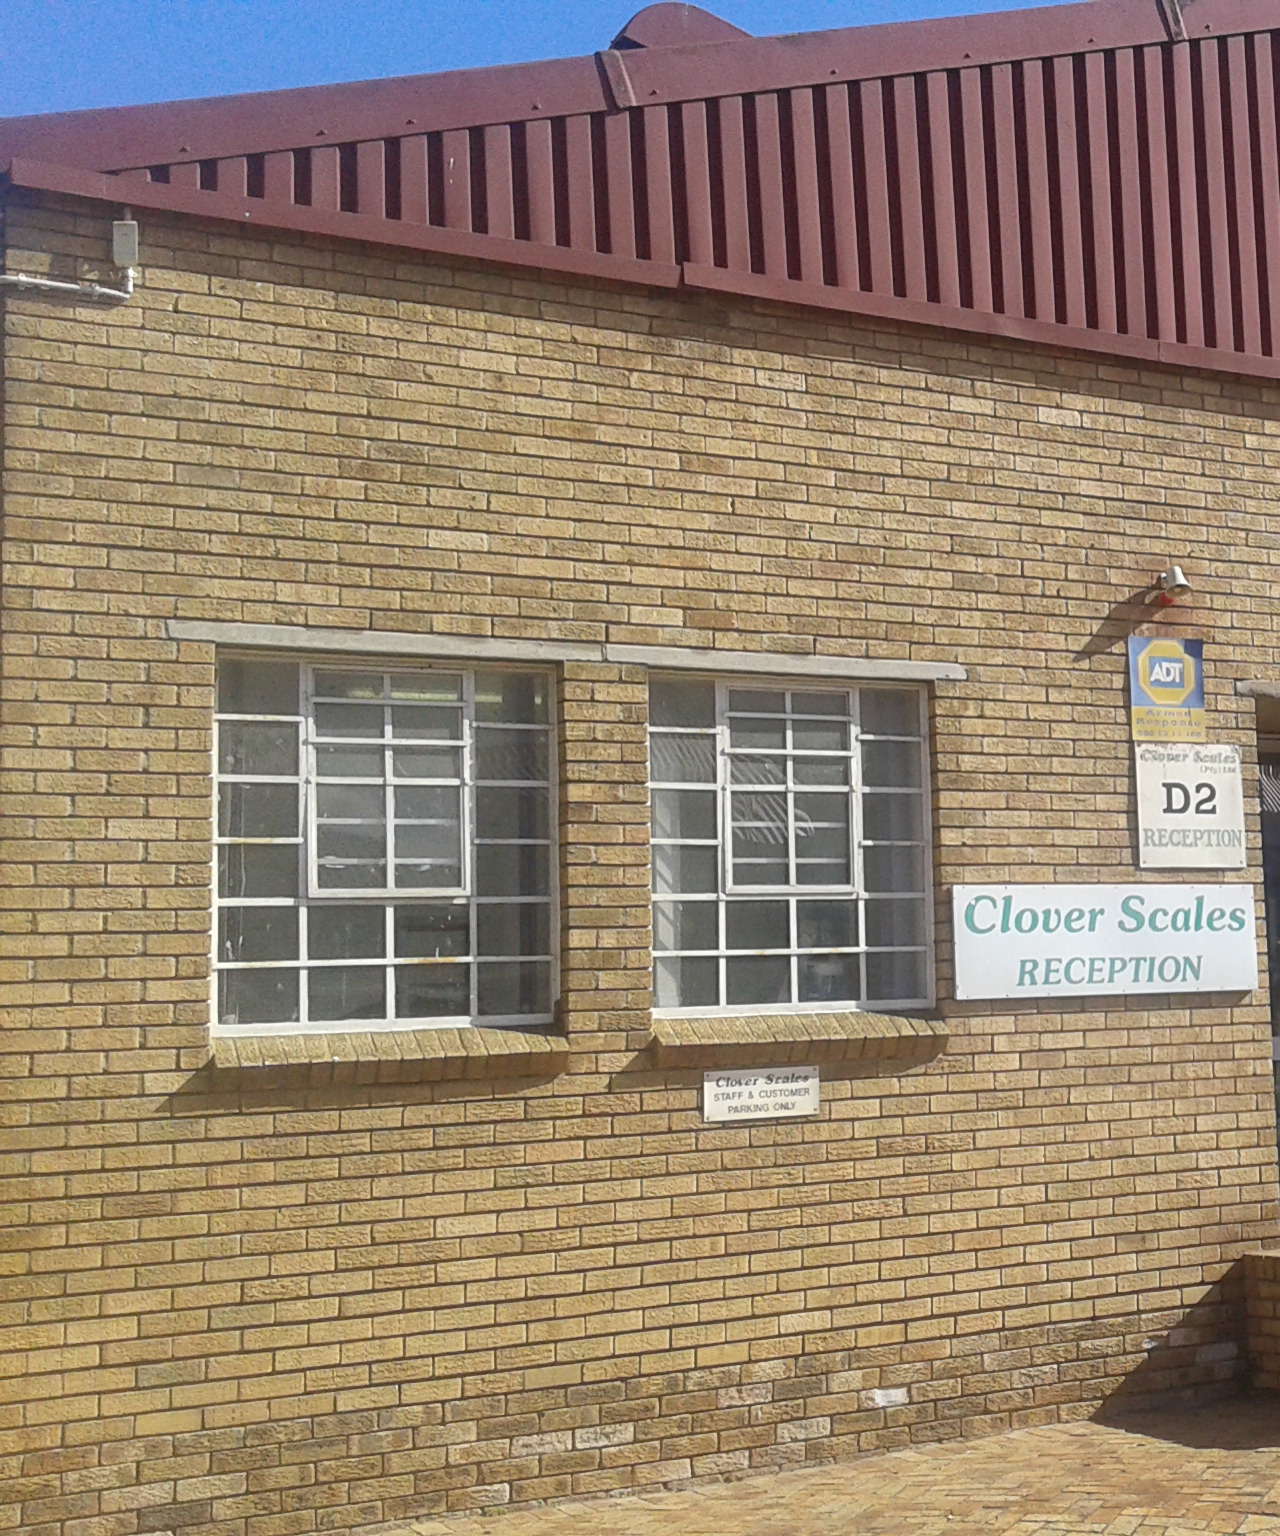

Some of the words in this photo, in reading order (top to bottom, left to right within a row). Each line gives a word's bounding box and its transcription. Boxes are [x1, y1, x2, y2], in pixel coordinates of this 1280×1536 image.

[1149, 661, 1183, 683] ADT
[1162, 782, 1217, 814] D2
[1142, 828, 1243, 848] RECEPTION
[964, 895, 1105, 934] Clover
[1117, 895, 1247, 933] Scales
[1016, 955, 1203, 987] RECEPTION
[715, 1076, 760, 1088] Clover
[765, 1073, 811, 1085] Scales
[714, 1090, 744, 1102] STAFF
[748, 1090, 754, 1099] &
[758, 1087, 810, 1099] CUSTOMER
[727, 1103, 769, 1114] PARKING
[773, 1101, 797, 1111] ONLY
